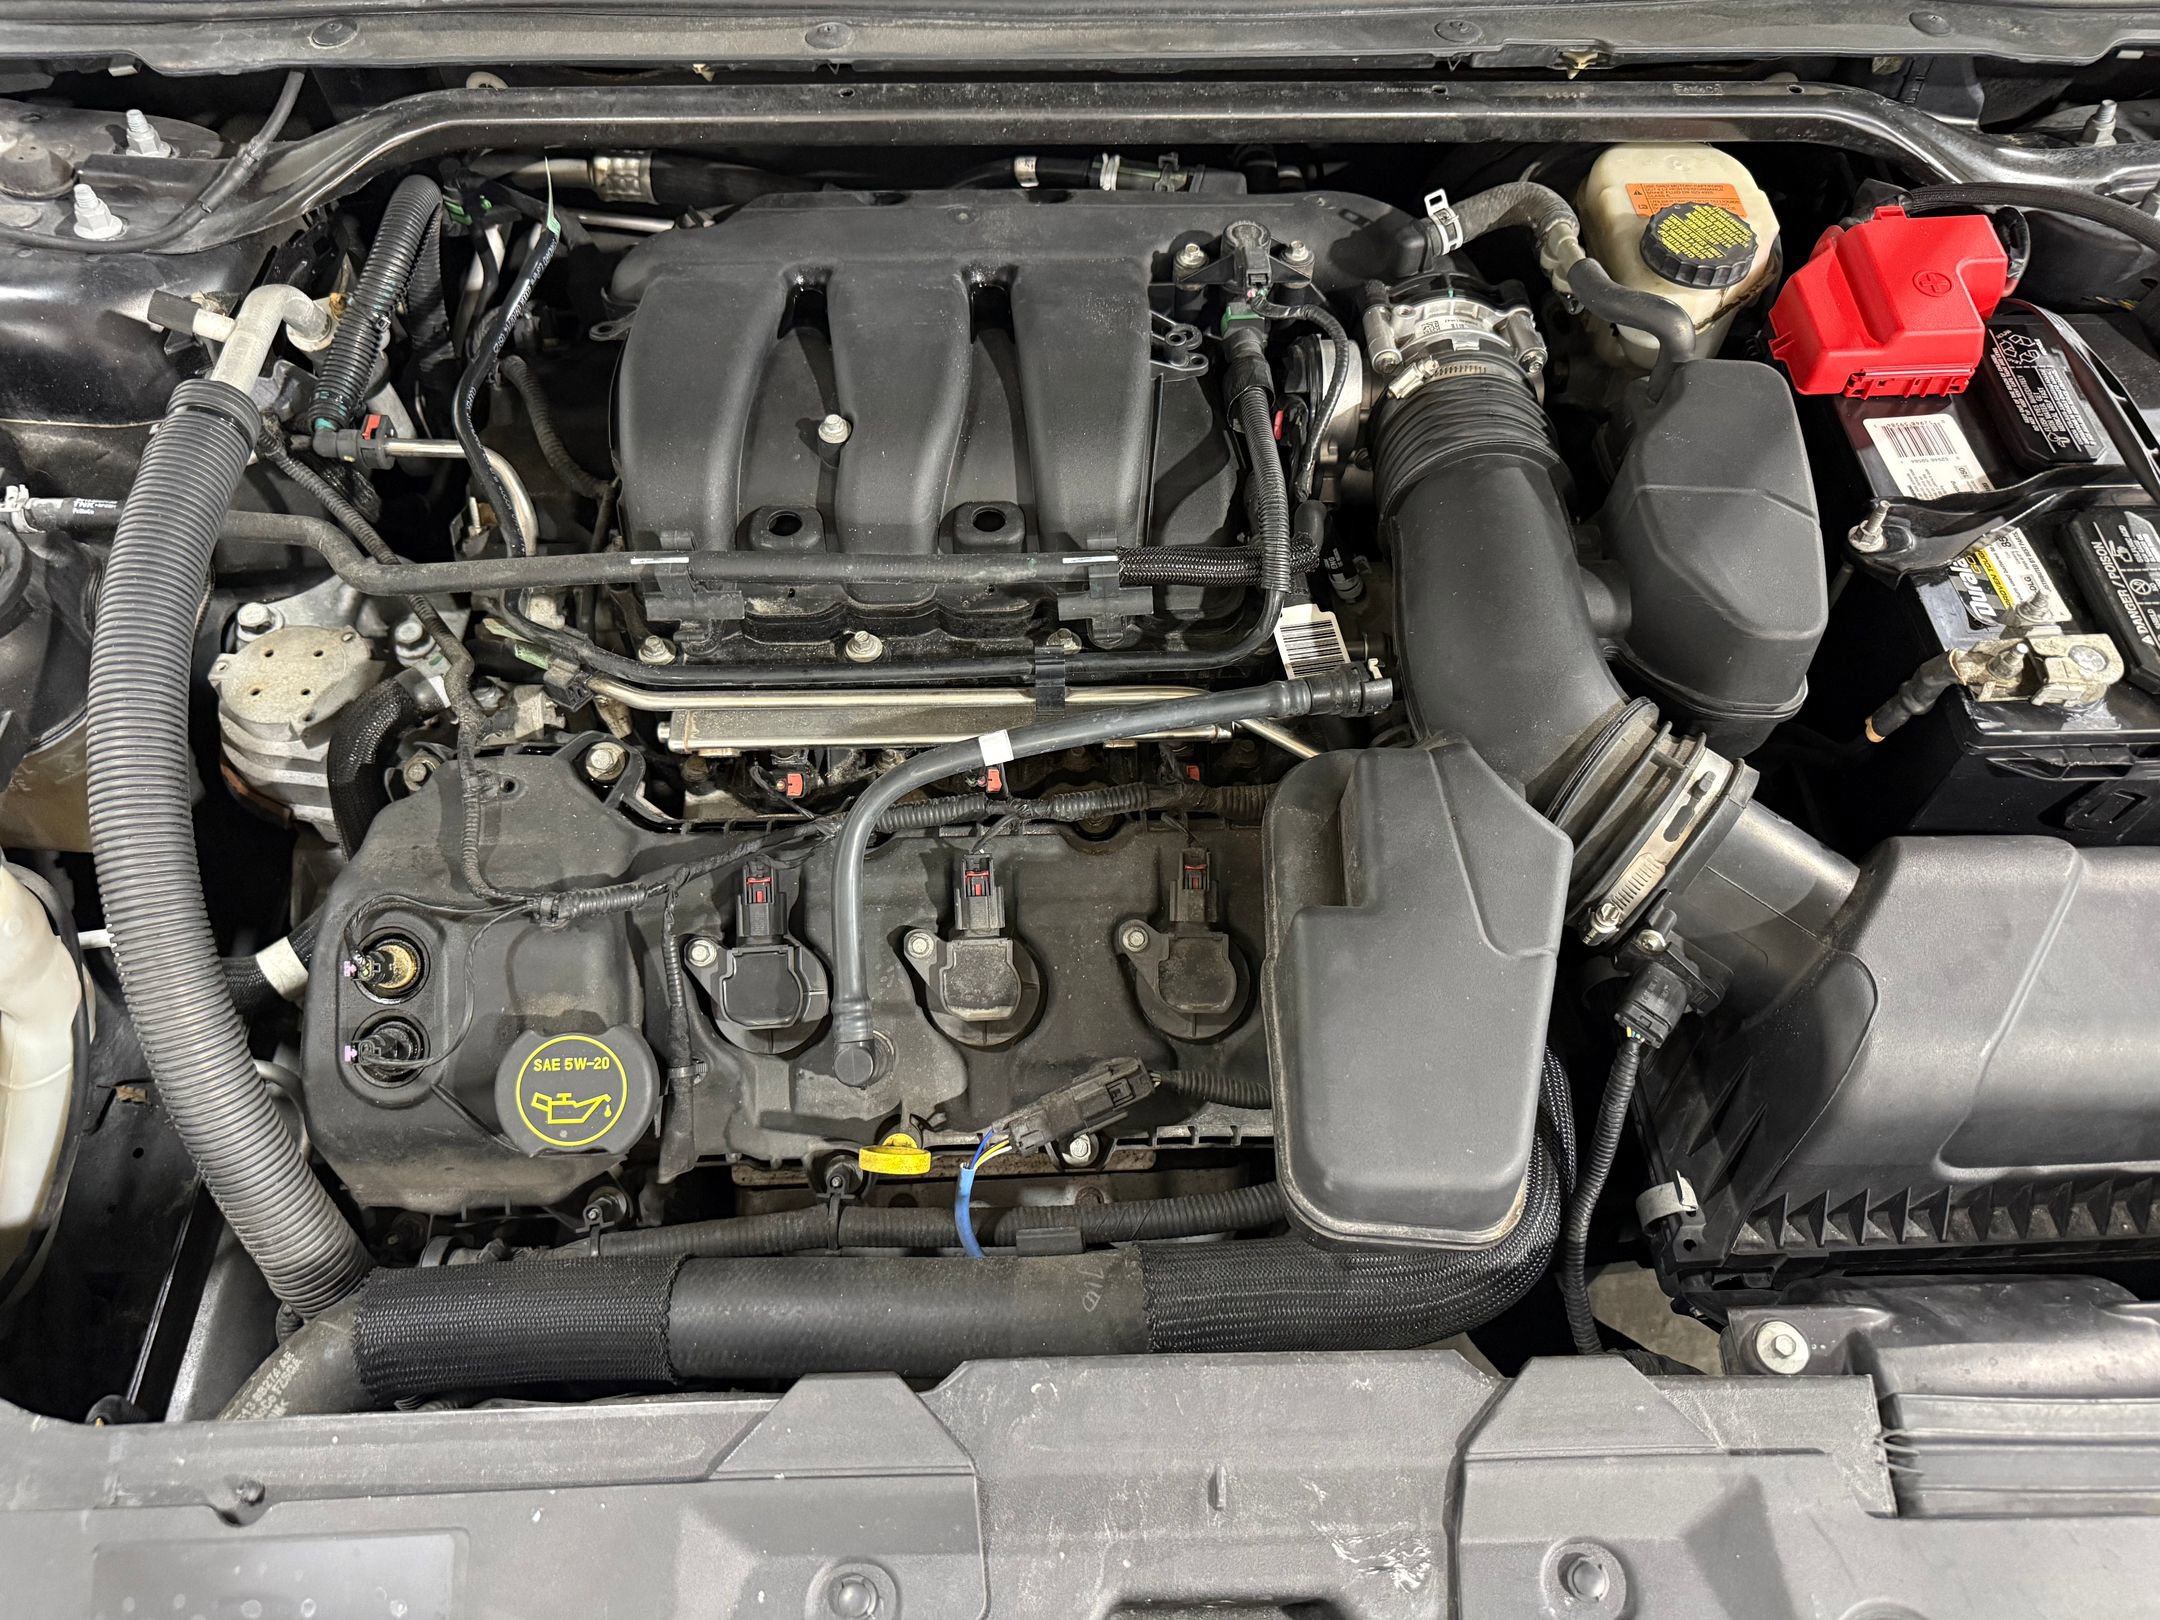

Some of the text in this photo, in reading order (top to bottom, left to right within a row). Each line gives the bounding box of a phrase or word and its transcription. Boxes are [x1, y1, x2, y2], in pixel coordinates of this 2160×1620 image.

[1991, 355, 2003, 371] CHILDREN
[2018, 376, 2052, 431] FLUSH EYES IMMEDIATELY
[2038, 387, 2066, 431] MEDICAL HELP FAST
[2048, 420, 2059, 431] WITH
[2020, 545, 2031, 557] BEST
[2091, 541, 2121, 579] POISON
[2117, 589, 2149, 634] DANGER
[533, 1056, 610, 1072] SAE 5W-20
